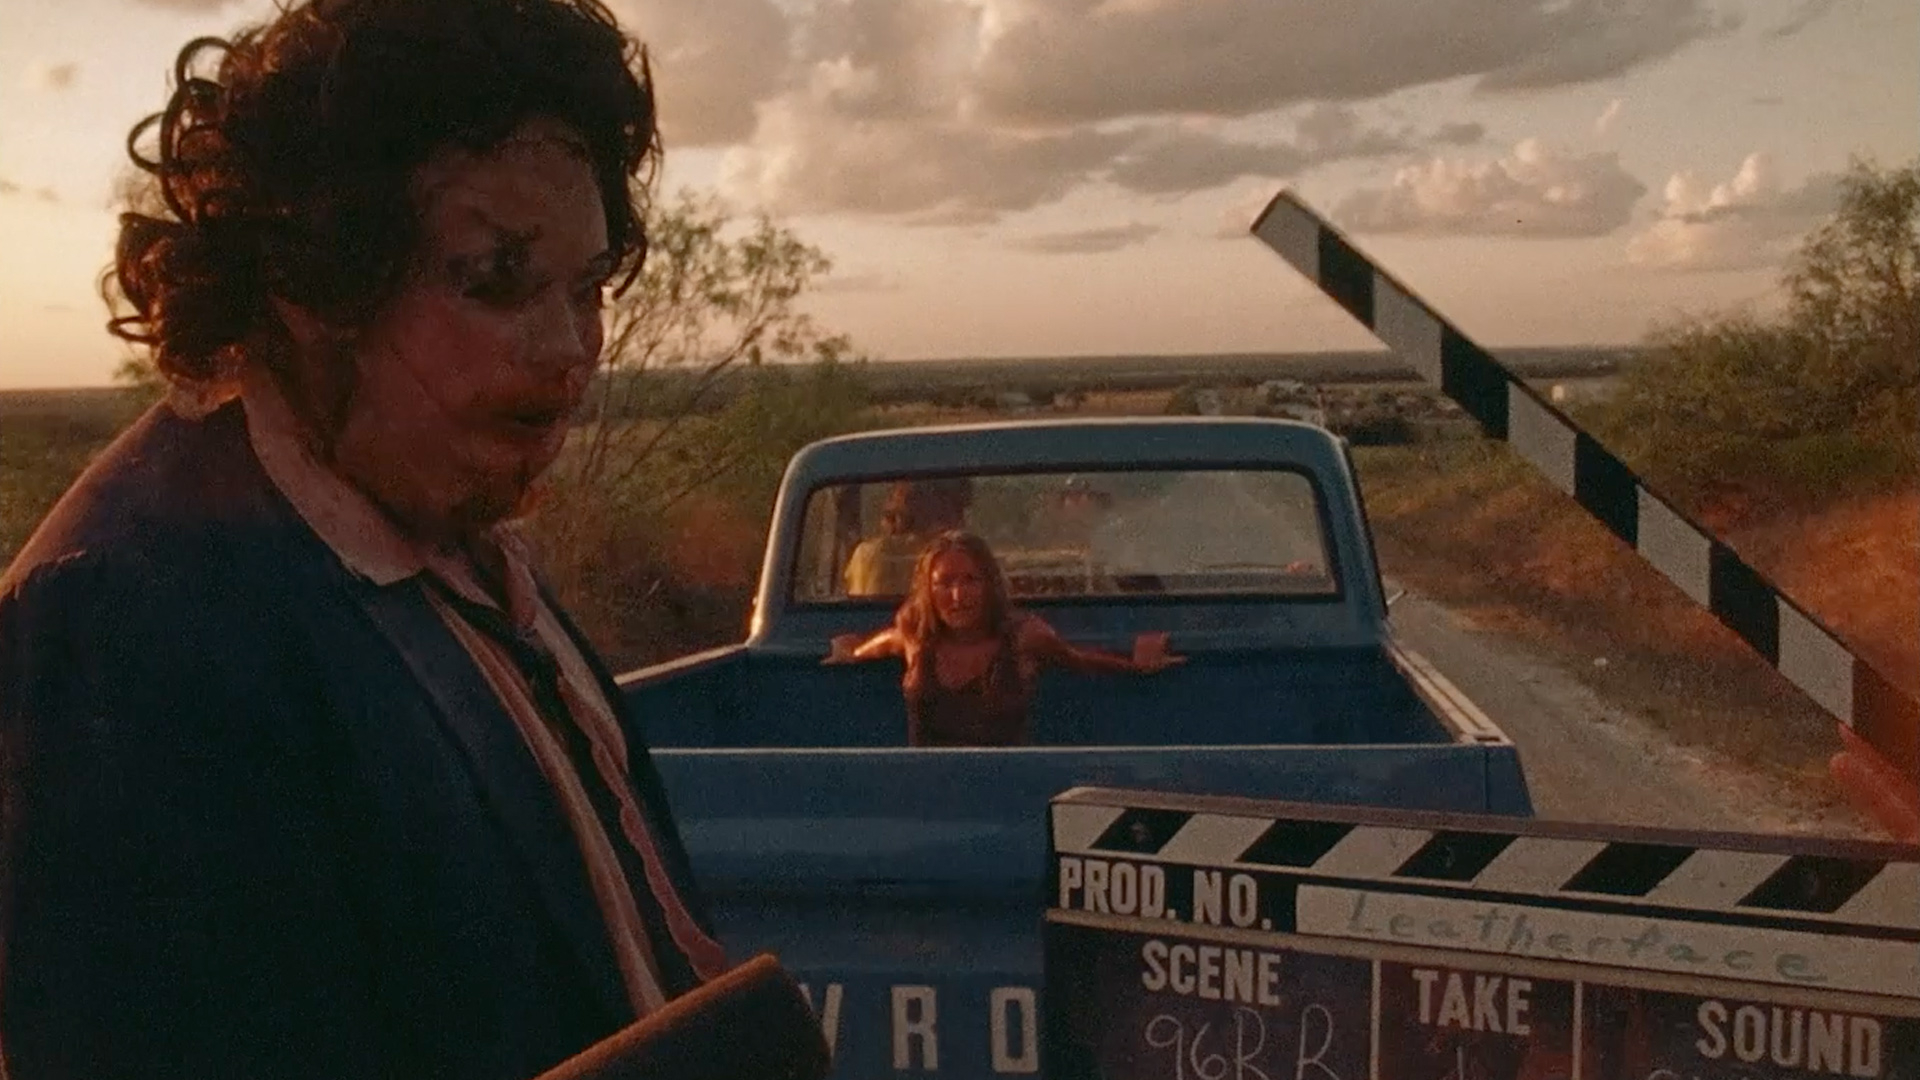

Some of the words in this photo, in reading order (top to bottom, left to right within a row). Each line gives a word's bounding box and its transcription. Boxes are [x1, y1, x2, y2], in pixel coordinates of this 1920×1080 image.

[1060, 857, 1176, 919] PROD.
[1193, 870, 1272, 930] NO.
[1141, 940, 1281, 1006] SCENE
[1412, 969, 1532, 1036] TAKE
[1696, 1001, 1881, 1077] SOUND
